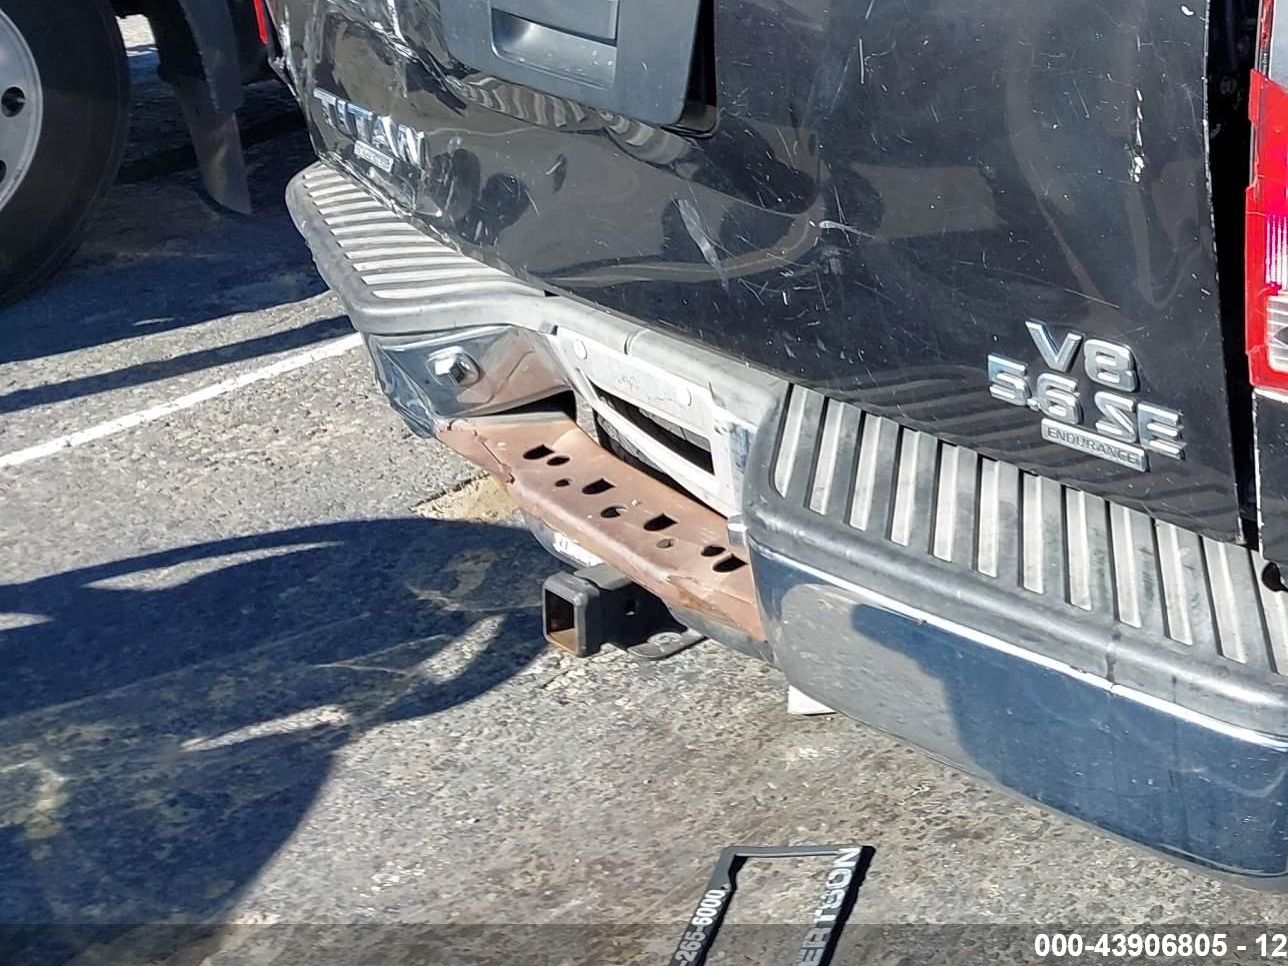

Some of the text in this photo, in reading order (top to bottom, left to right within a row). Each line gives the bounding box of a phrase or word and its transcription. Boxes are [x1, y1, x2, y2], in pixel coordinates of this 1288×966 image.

[1025, 318, 1139, 392] V8
[1047, 427, 1139, 464] ENDURANCE
[1094, 390, 1186, 461] SE
